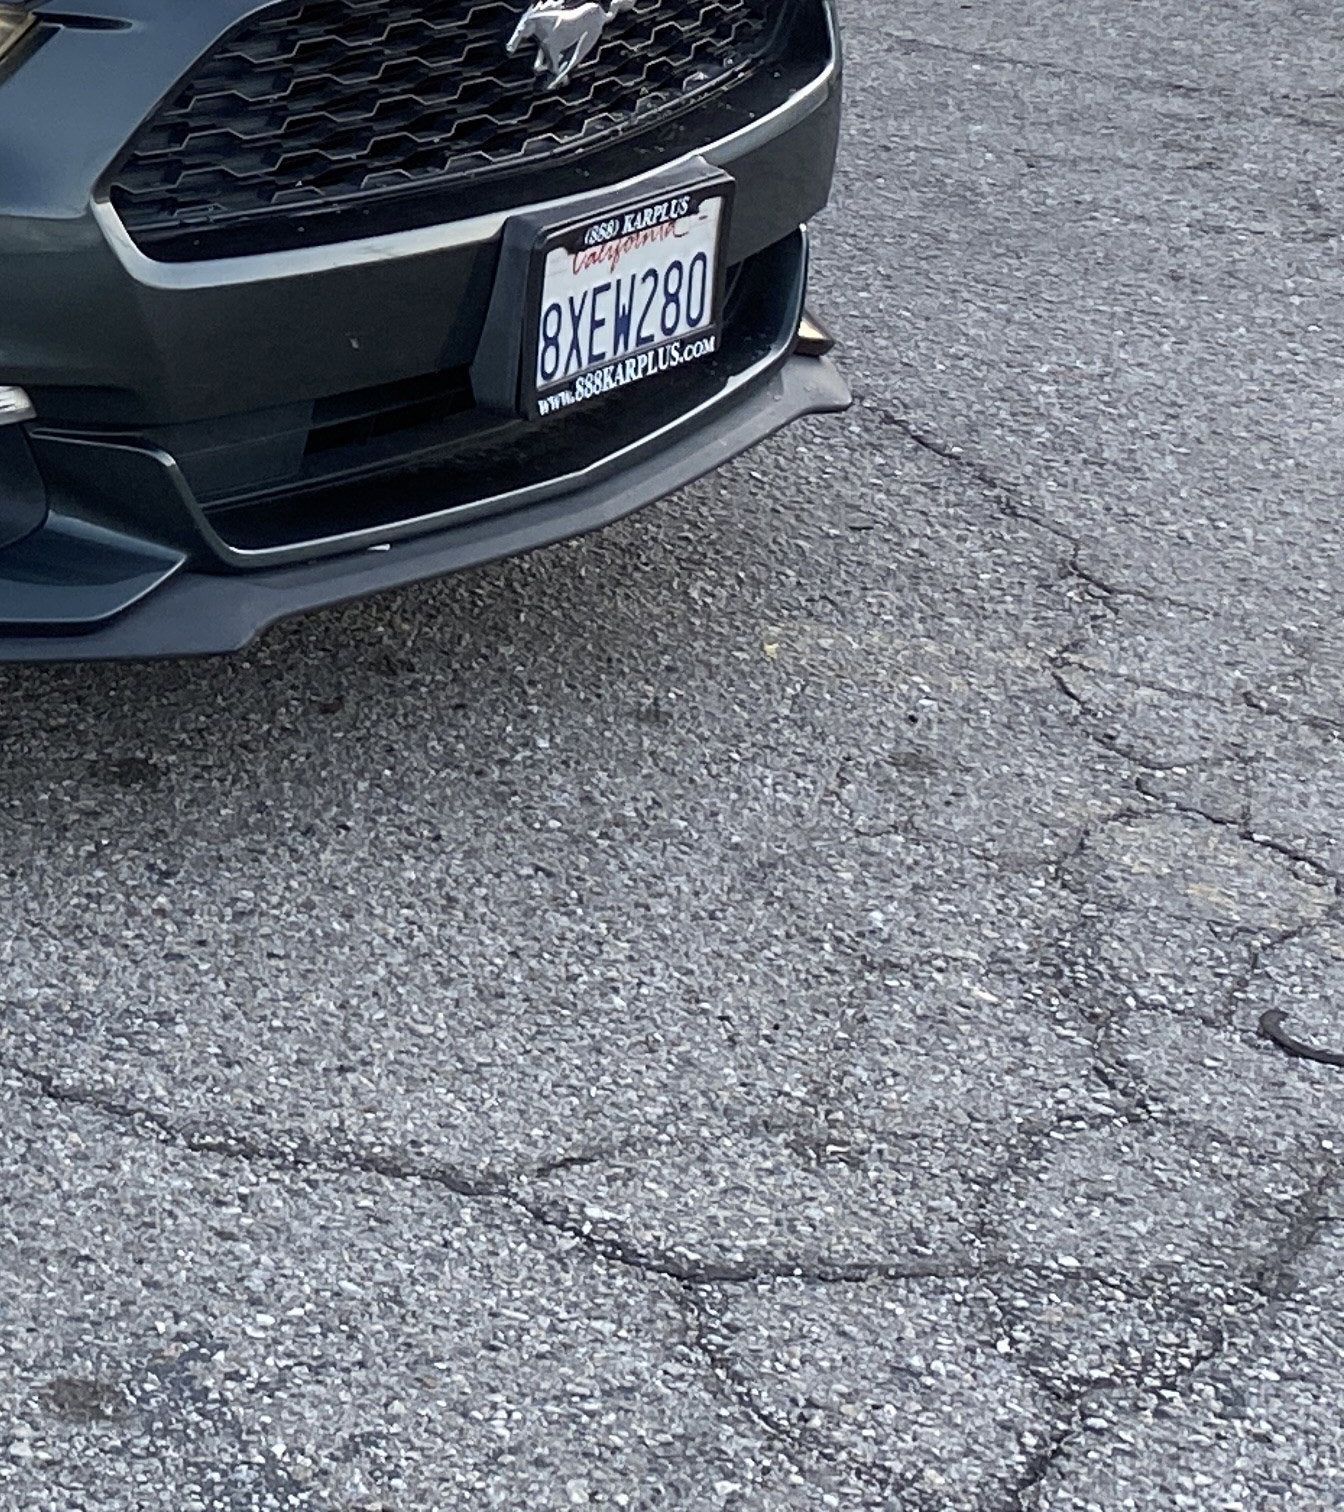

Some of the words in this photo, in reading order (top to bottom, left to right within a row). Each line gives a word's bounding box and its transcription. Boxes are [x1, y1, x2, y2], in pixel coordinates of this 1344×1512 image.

[572, 219, 690, 275] California
[584, 218, 619, 245] (888)
[621, 195, 691, 235] KARPLUS
[540, 251, 708, 381] 8XEW280
